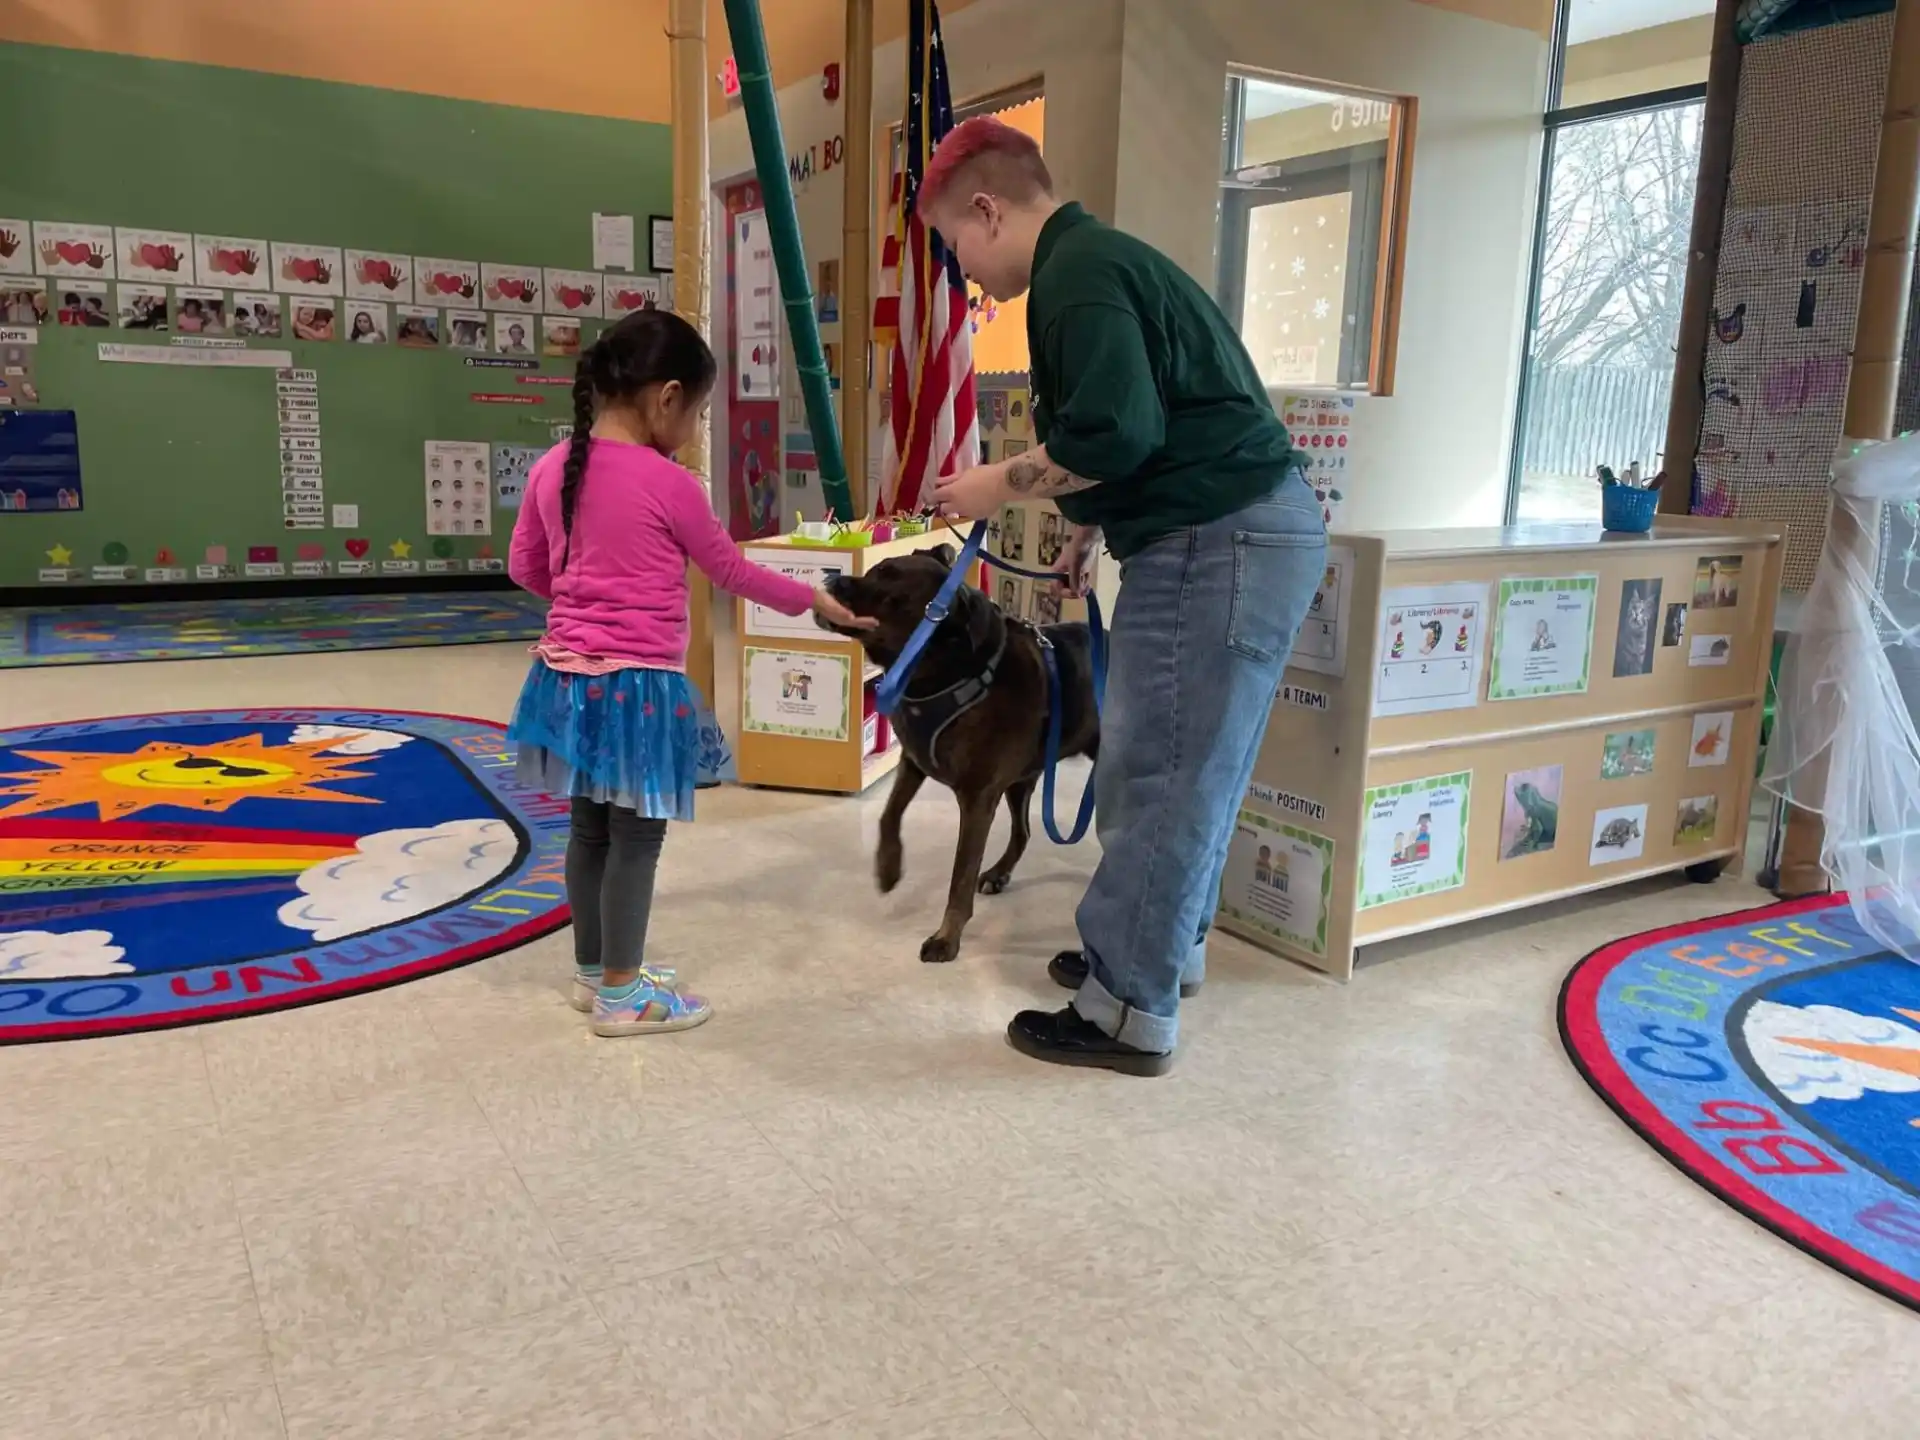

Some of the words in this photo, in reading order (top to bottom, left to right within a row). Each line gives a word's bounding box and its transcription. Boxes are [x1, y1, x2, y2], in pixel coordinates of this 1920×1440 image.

[823, 135, 843, 170] BO
[0, 332, 27, 341] pers
[298, 412, 311, 420] cat
[297, 440, 315, 448] bird
[301, 480, 316, 488] dog
[1284, 687, 1290, 700] A
[1294, 688, 1327, 709] TEAM!
[333, 713, 404, 725] Cc
[1249, 784, 1273, 801] think
[1277, 792, 1325, 820] POSITIVE!
[49, 843, 204, 854] ORANGE
[20, 860, 177, 872] YELLOW
[0, 874, 148, 890] GREEN
[1626, 1024, 1729, 1082] Cc
[1693, 1099, 1849, 1176] Bb
